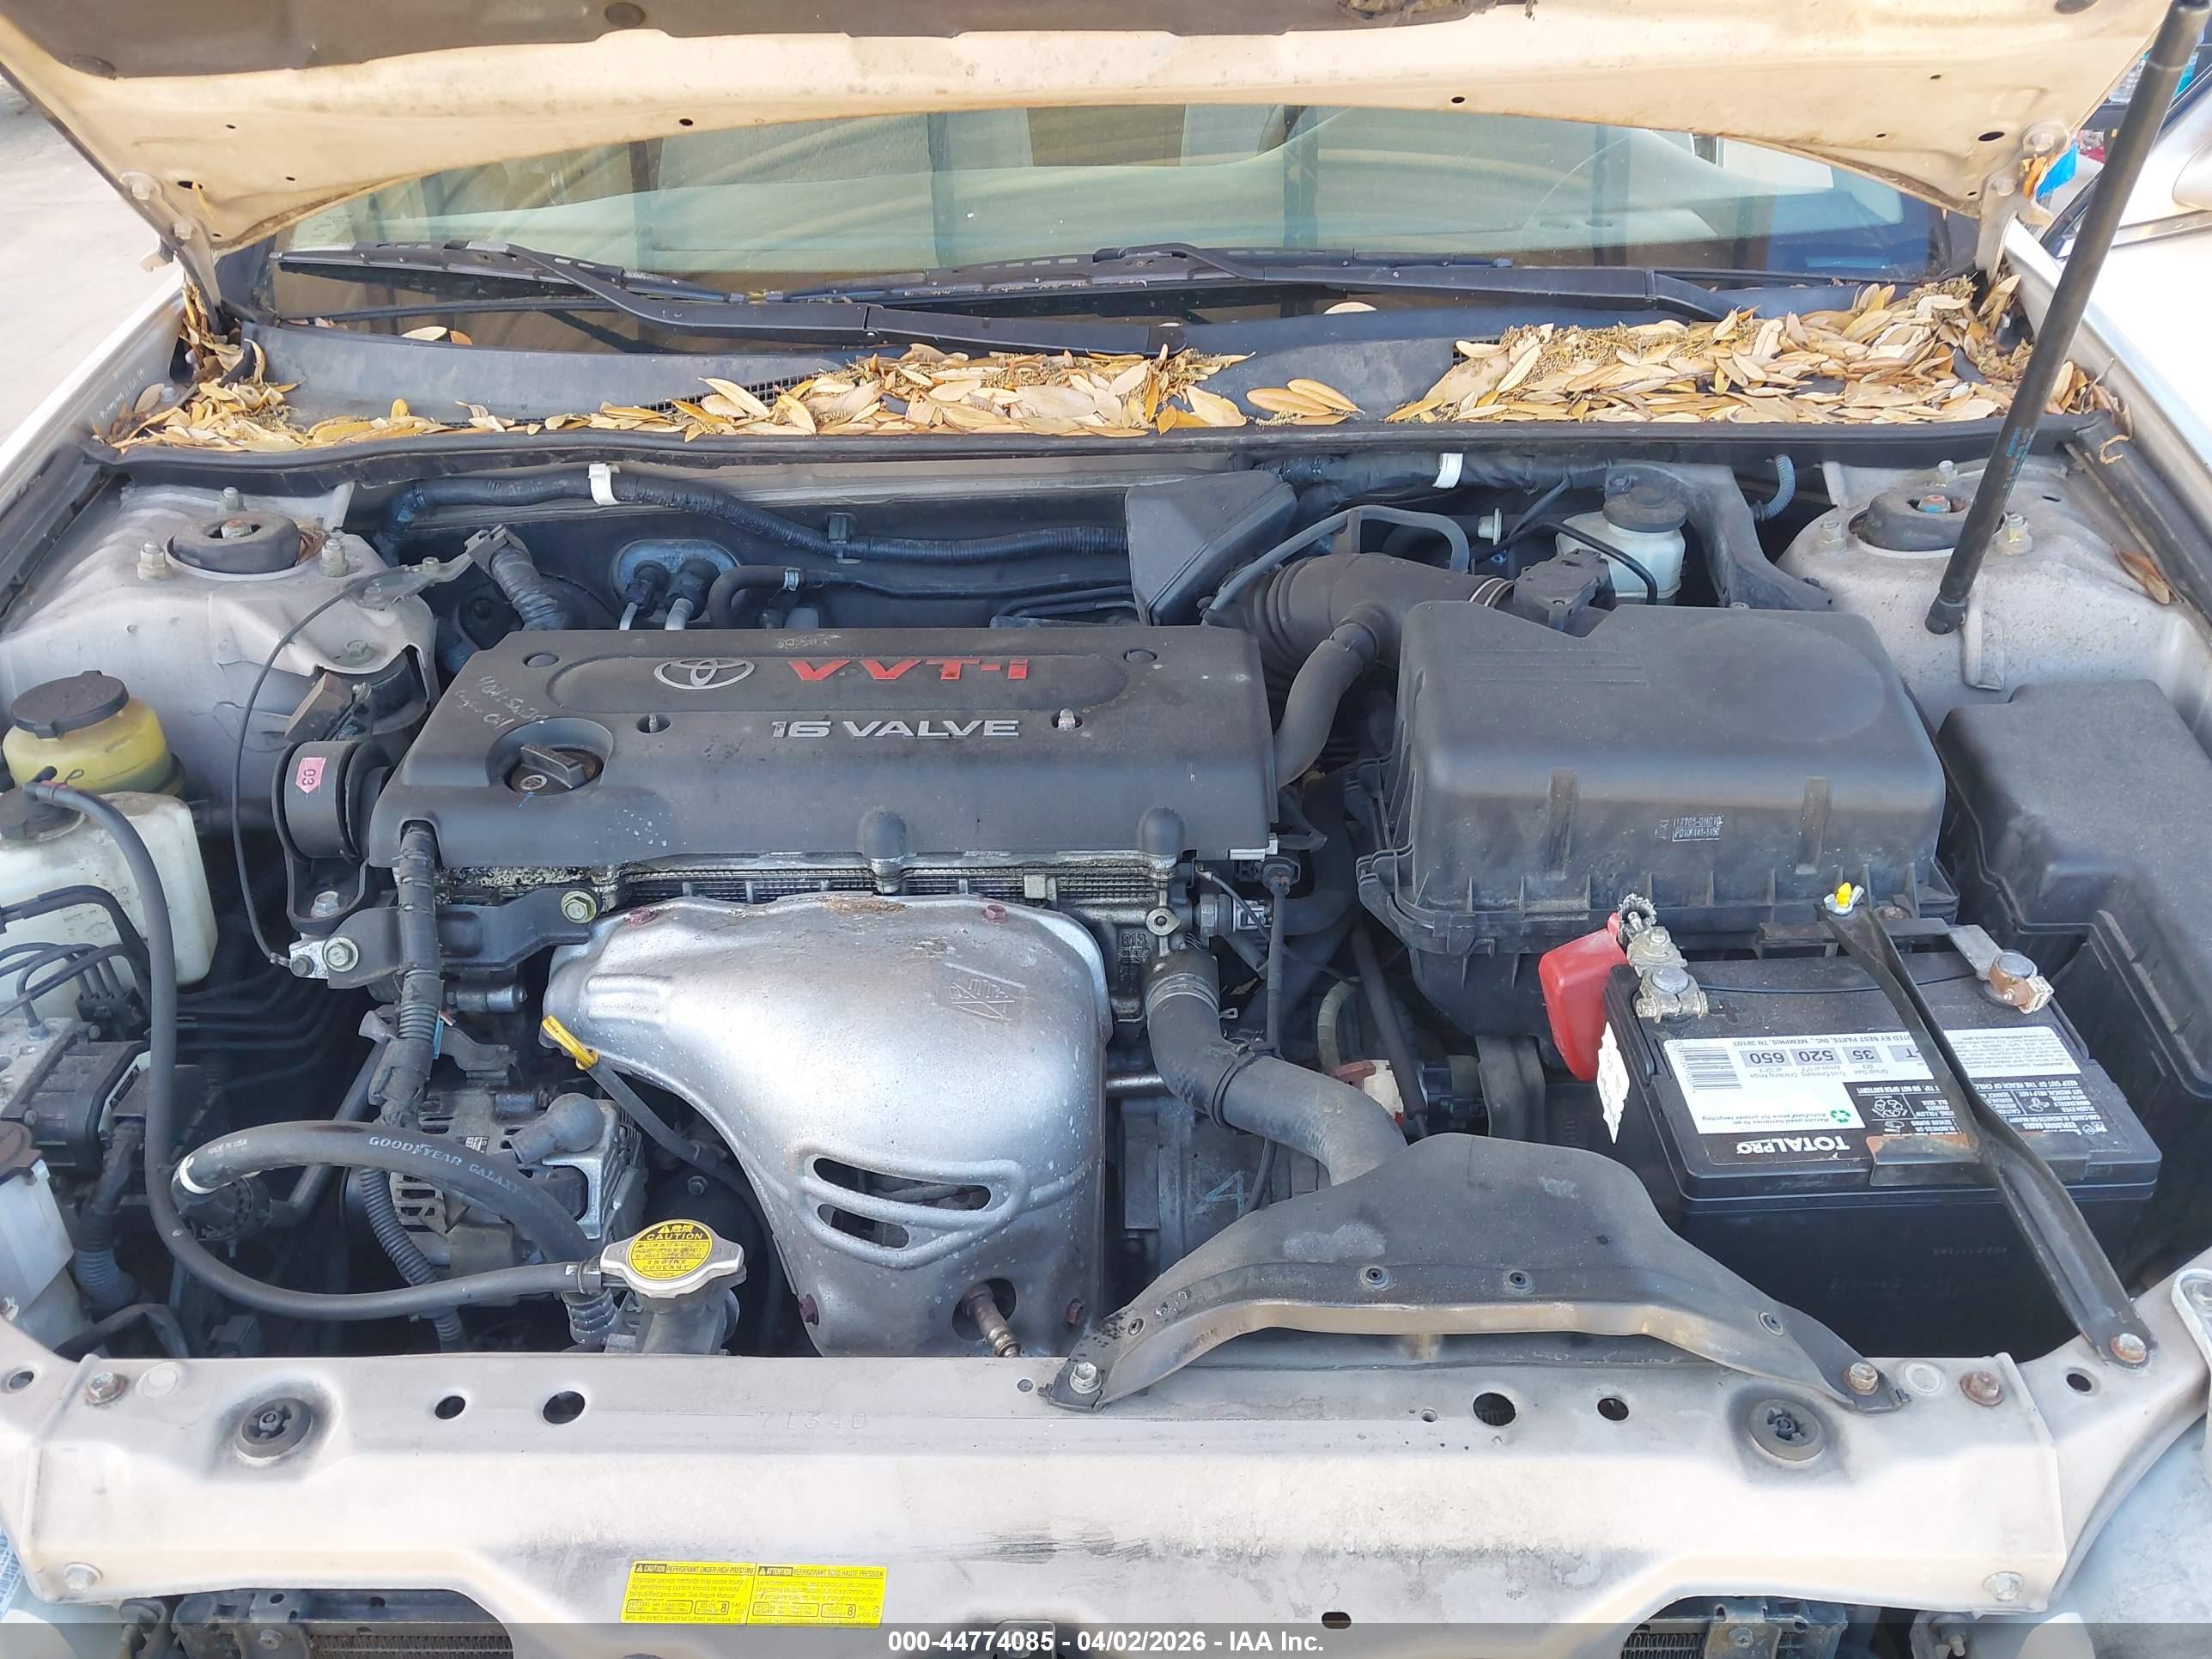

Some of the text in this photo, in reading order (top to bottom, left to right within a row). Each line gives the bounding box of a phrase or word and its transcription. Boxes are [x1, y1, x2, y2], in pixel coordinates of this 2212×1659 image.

[773, 720, 1020, 739] 16 VALVE
[1749, 1052, 1785, 1065] 650
[1798, 1050, 1834, 1063] 520
[1852, 1049, 1875, 1060] 35
[1736, 1135, 1851, 1155] TOTALPRO
[368, 1136, 463, 1167] GOODYEAR
[644, 1565, 666, 1573] CAUTION
[859, 1570, 884, 1578] PRESSION
[720, 1602, 727, 1613] 8
[847, 1606, 854, 1616] 8
